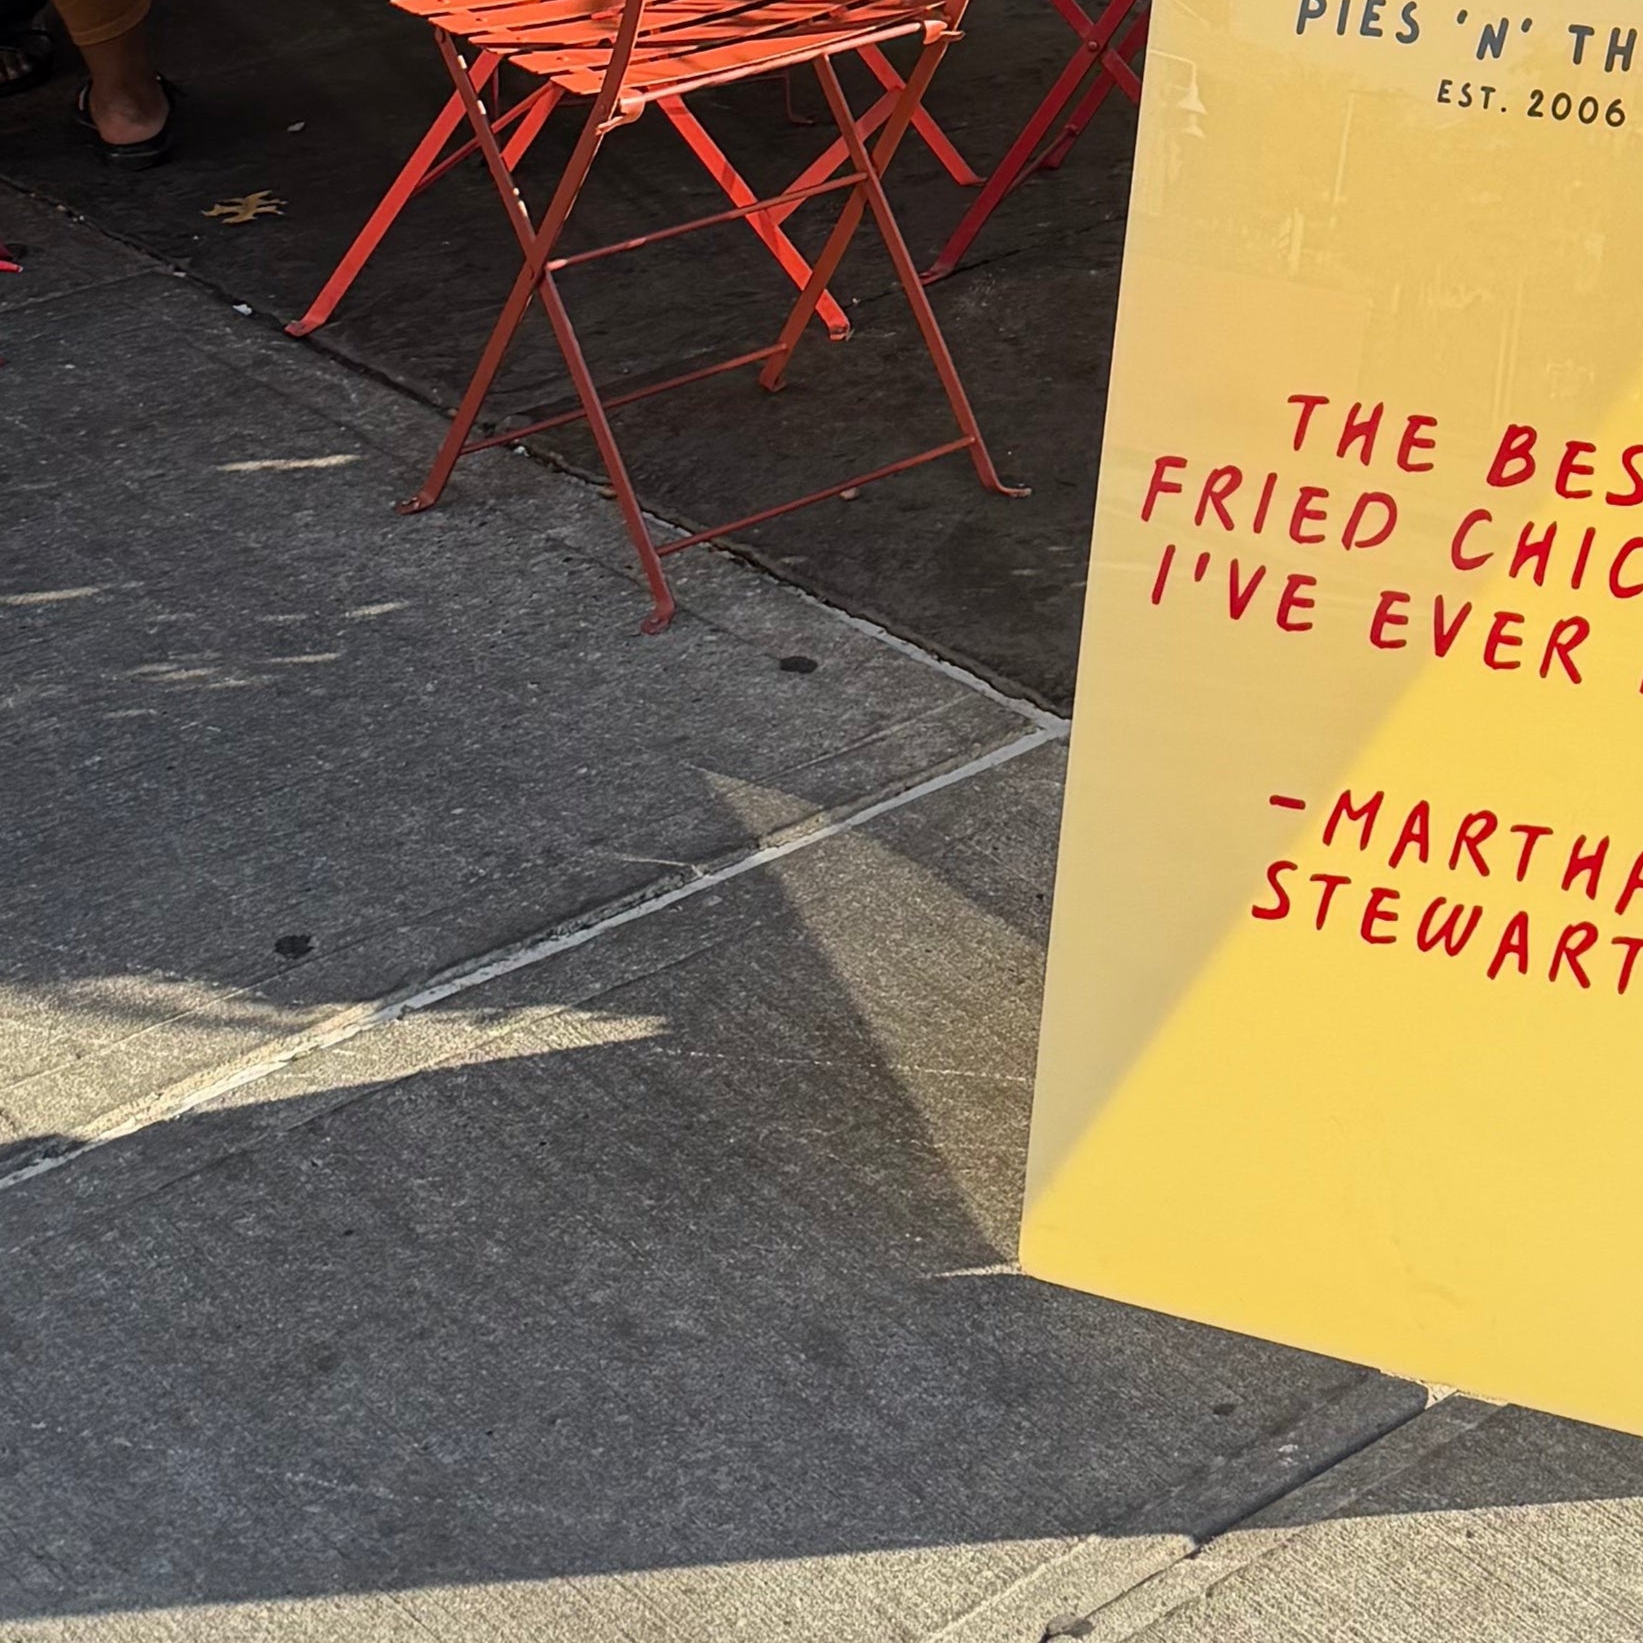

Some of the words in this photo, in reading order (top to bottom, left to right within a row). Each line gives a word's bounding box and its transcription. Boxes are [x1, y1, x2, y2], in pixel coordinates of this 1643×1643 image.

[1456, 8, 1534, 60] 'N'
[1436, 79, 1507, 114] EST.
[1526, 88, 1627, 128] 2006
[1287, 394, 1438, 473] THE
[1140, 455, 1398, 551] FRIED
[1151, 544, 1318, 633] I'VE
[1369, 590, 1592, 685] EVER
